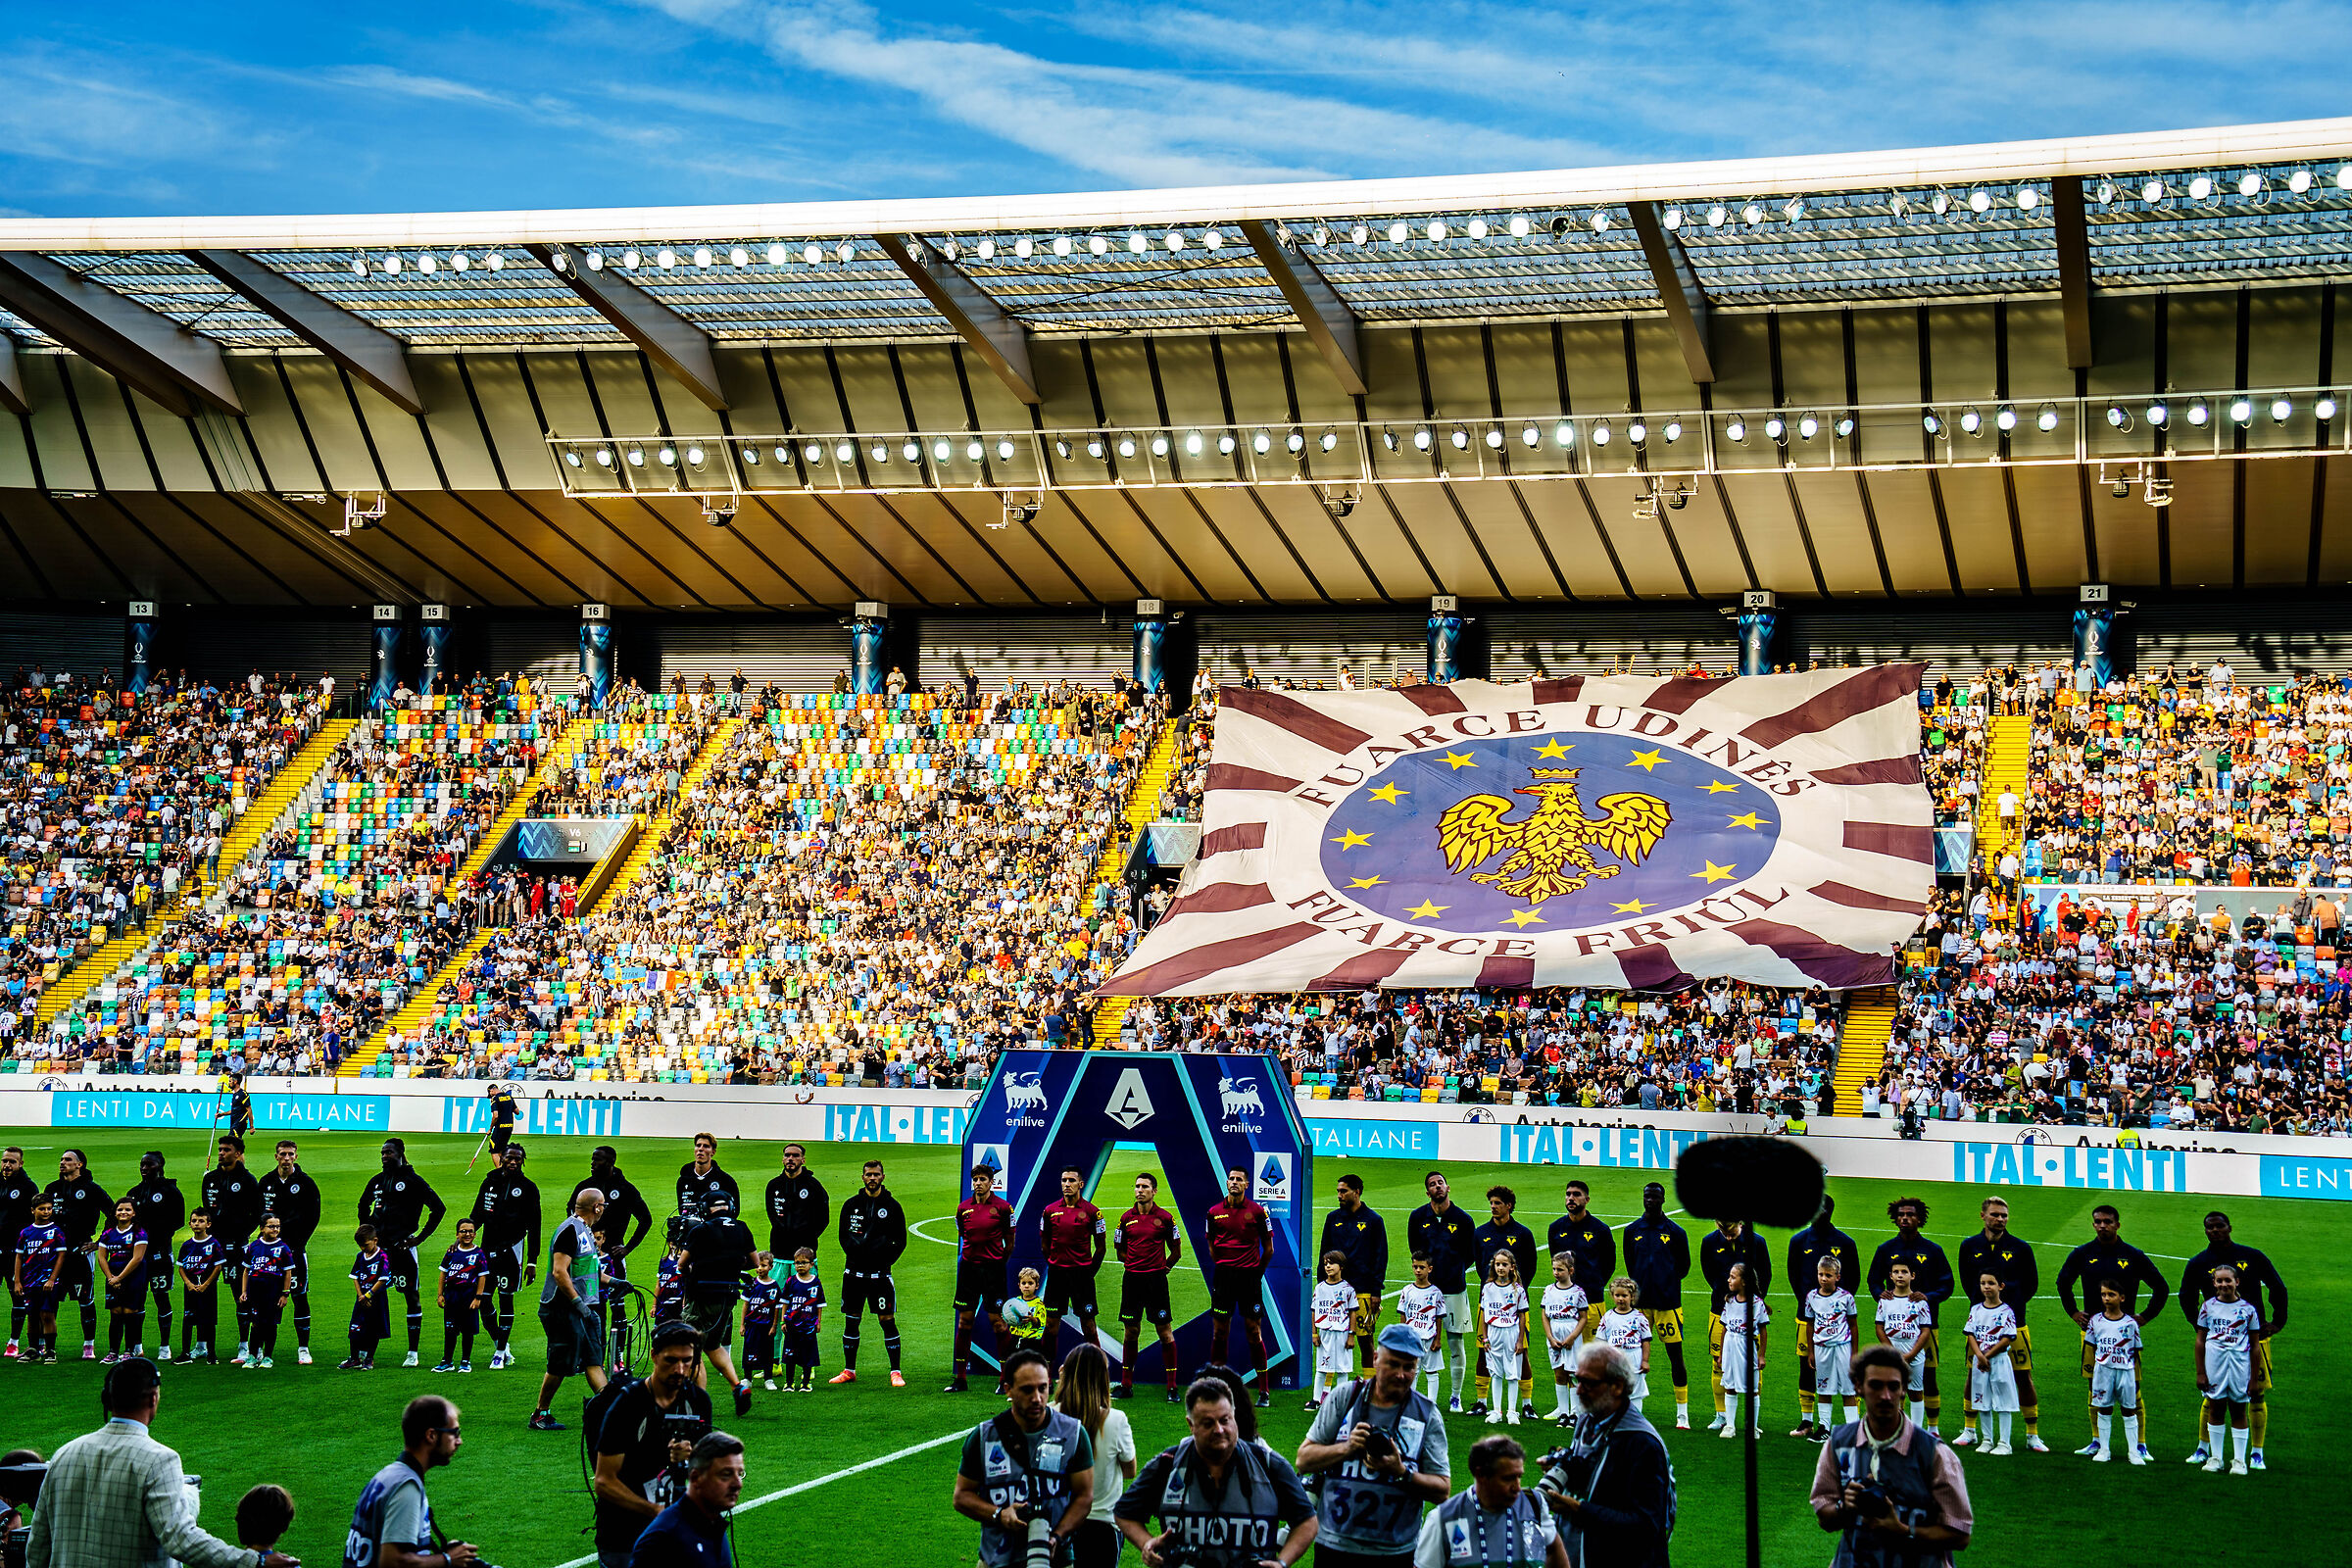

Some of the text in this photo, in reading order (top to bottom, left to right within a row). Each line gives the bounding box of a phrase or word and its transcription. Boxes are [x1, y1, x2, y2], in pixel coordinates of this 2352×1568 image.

[2088, 588, 2101, 599] 21
[1438, 599, 1450, 609] 19
[1750, 594, 1764, 604] 20
[135, 605, 148, 613] 13
[427, 607, 438, 615] 15
[588, 606, 599, 615] 16
[1143, 602, 1153, 612] 18
[378, 609, 390, 617] 14
[1296, 705, 1818, 808] FUARCE UDINÊS
[569, 828, 581, 837] V6
[1286, 887, 1790, 956] FUARCE FRIÛL
[66, 1101, 376, 1122] LENTI DA VIS ITALIANE
[1467, 1109, 1492, 1118] BMW
[1005, 1115, 1045, 1127] enilive
[1222, 1122, 1262, 1134] enilive
[1311, 1128, 1422, 1151] TALIANE
[2020, 1129, 2048, 1140] BMW
[223, 1266, 237, 1280] 14
[152, 1276, 168, 1290] 33
[878, 1297, 887, 1310] 8
[1318, 1307, 1342, 1316] RACISM
[1448, 1312, 1455, 1327] 1
[1887, 1313, 1906, 1322] KEEP
[2212, 1318, 2232, 1327] KEEP
[1413, 1320, 1428, 1329] OUT
[1657, 1322, 1676, 1338] 36
[1826, 1327, 1839, 1336] OUT
[1901, 1330, 1916, 1339] OUT
[2010, 1348, 2028, 1365] 15
[2111, 1355, 2126, 1364] OUT
[1331, 1487, 1404, 1532] 327
[1164, 1516, 1269, 1548] PHOTO
